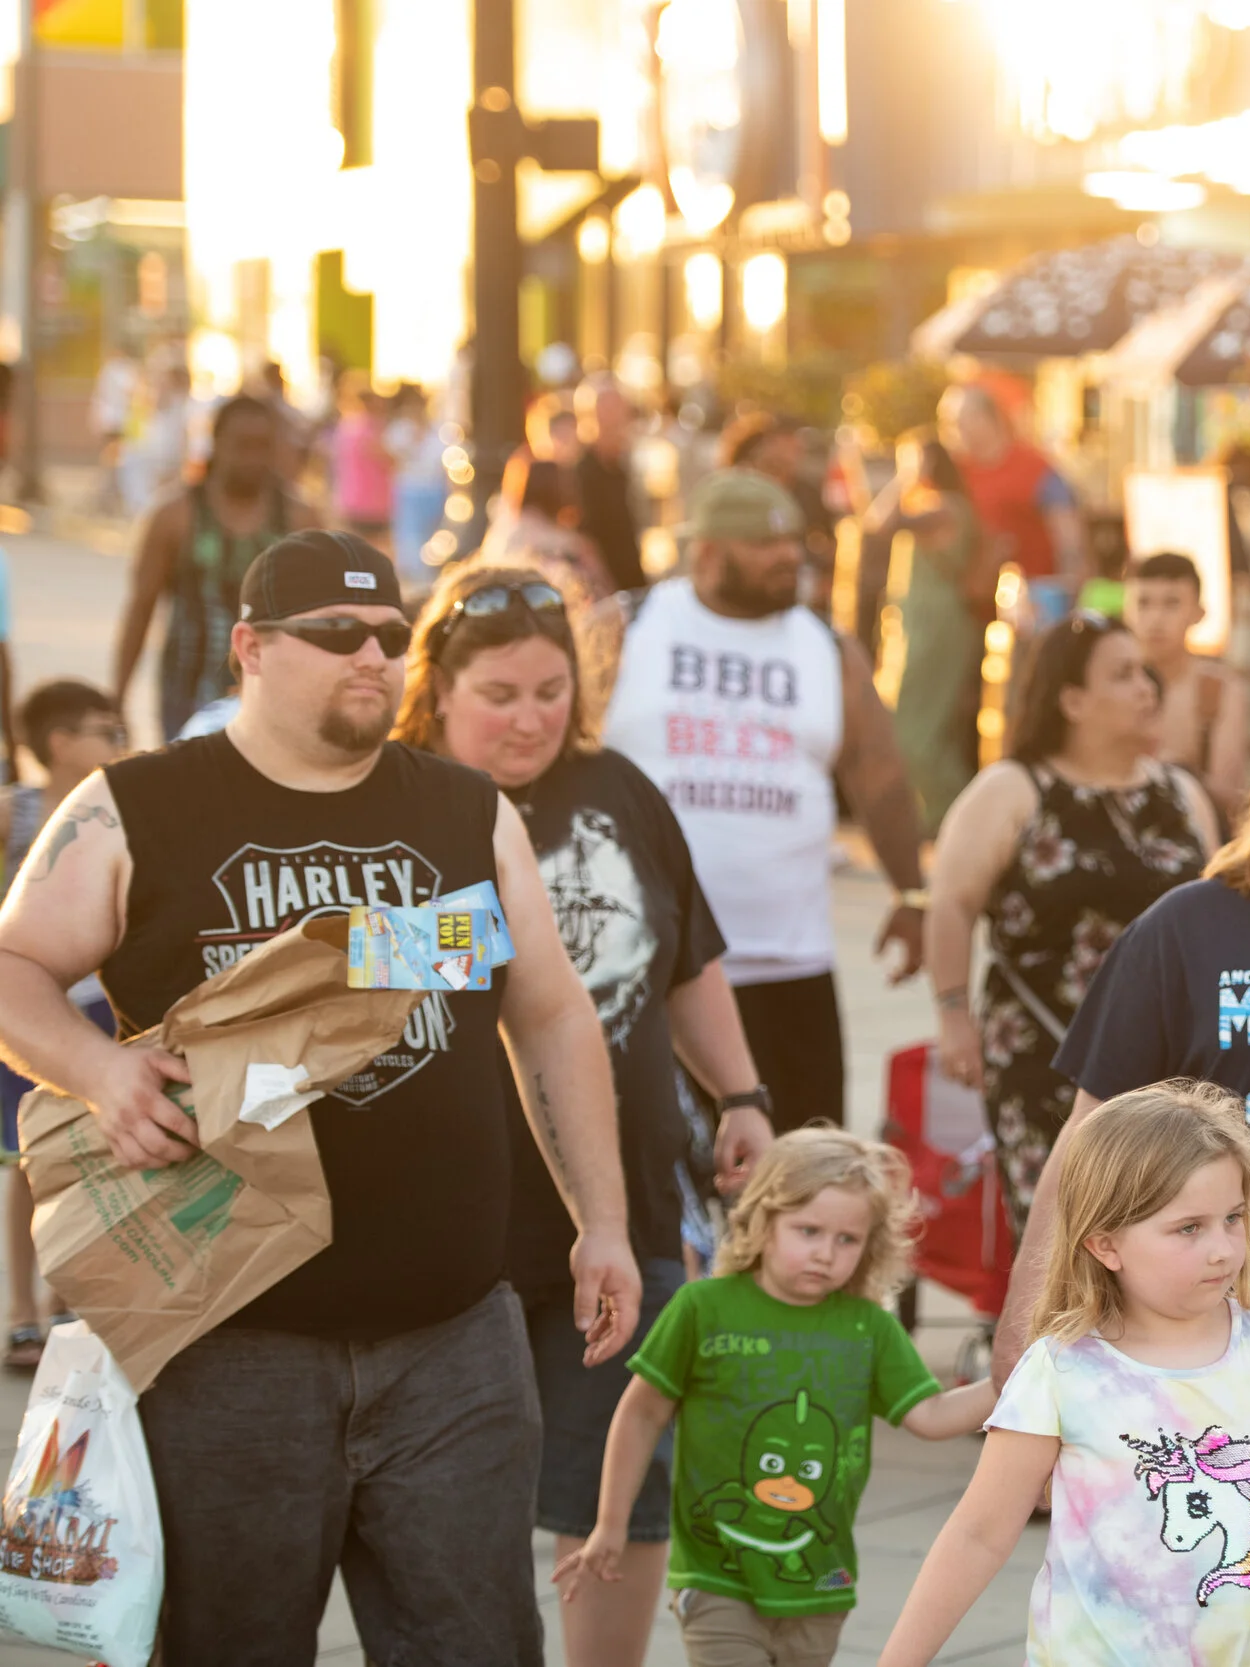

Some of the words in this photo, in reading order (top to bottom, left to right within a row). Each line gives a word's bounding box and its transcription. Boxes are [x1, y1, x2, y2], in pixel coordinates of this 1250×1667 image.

[670, 643, 798, 707] BBQ
[439, 915, 454, 948] TOY
[456, 915, 472, 949] FUN
